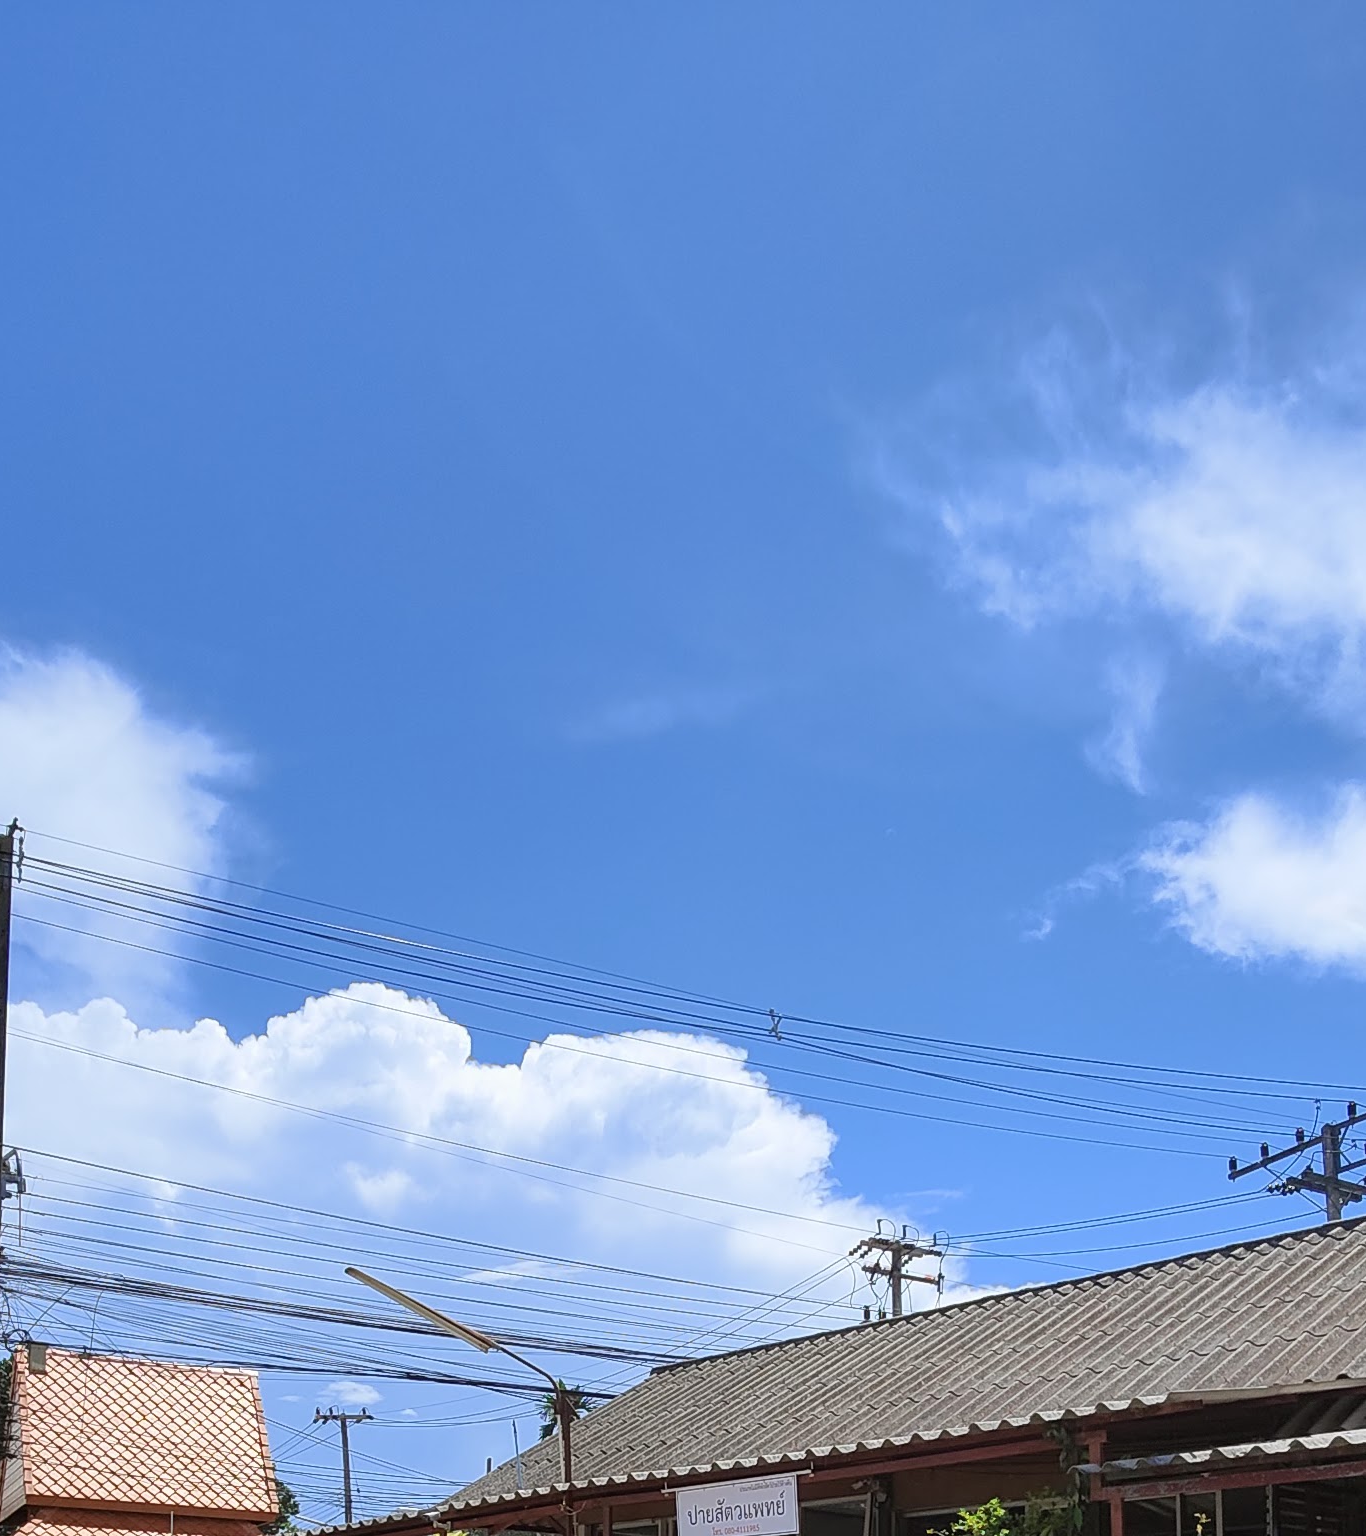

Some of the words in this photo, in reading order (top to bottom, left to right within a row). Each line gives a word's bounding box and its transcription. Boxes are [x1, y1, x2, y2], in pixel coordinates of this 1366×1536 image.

[687, 1491, 785, 1526] ปายสัตวแพทย์
